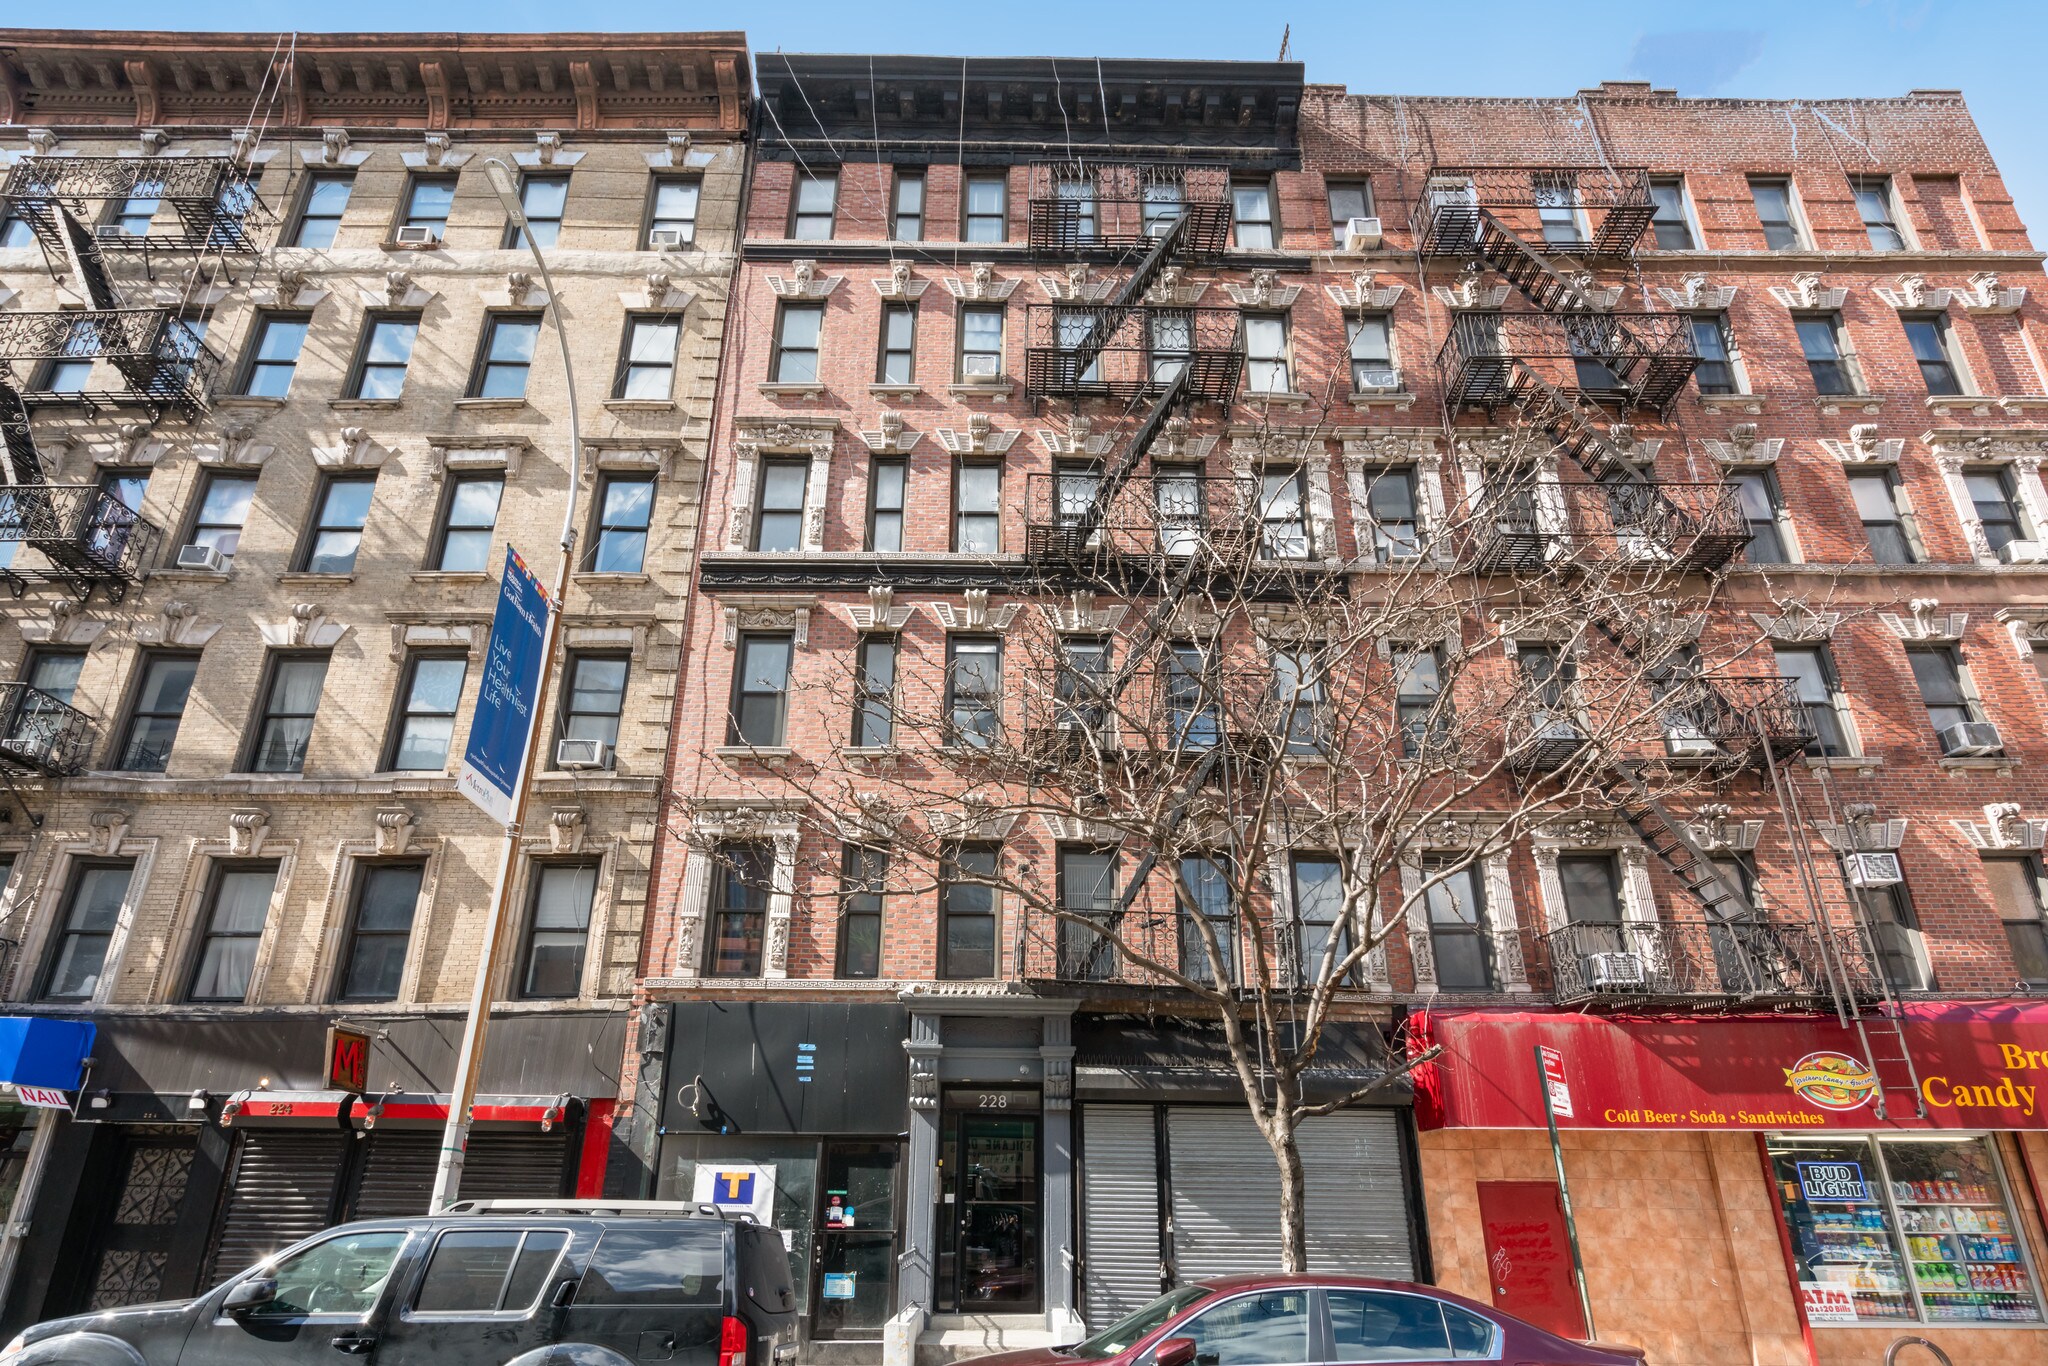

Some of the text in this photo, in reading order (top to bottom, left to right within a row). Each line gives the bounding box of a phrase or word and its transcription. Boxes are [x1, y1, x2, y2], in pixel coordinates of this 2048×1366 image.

[504, 586, 525, 617] Gotham
[494, 634, 512, 661] Live
[492, 649, 511, 680] Your
[484, 683, 501, 711] Life.
[487, 667, 528, 718] Healthiest
[1822, 1074, 1844, 1086] Candy
[20, 1087, 70, 1107] NAIL
[979, 1094, 1007, 1108] 228
[1921, 1076, 2037, 1116] Candy
[269, 1102, 292, 1115] 224
[1604, 1109, 1825, 1125] Cold Beer Soda Sandwiches
[1808, 1165, 1852, 1181] BUD
[721, 1172, 750, 1199] T
[1804, 1180, 1862, 1197] LIGHT
[1801, 1289, 1850, 1305] ATM
[1835, 1304, 1852, 1313] Bills
